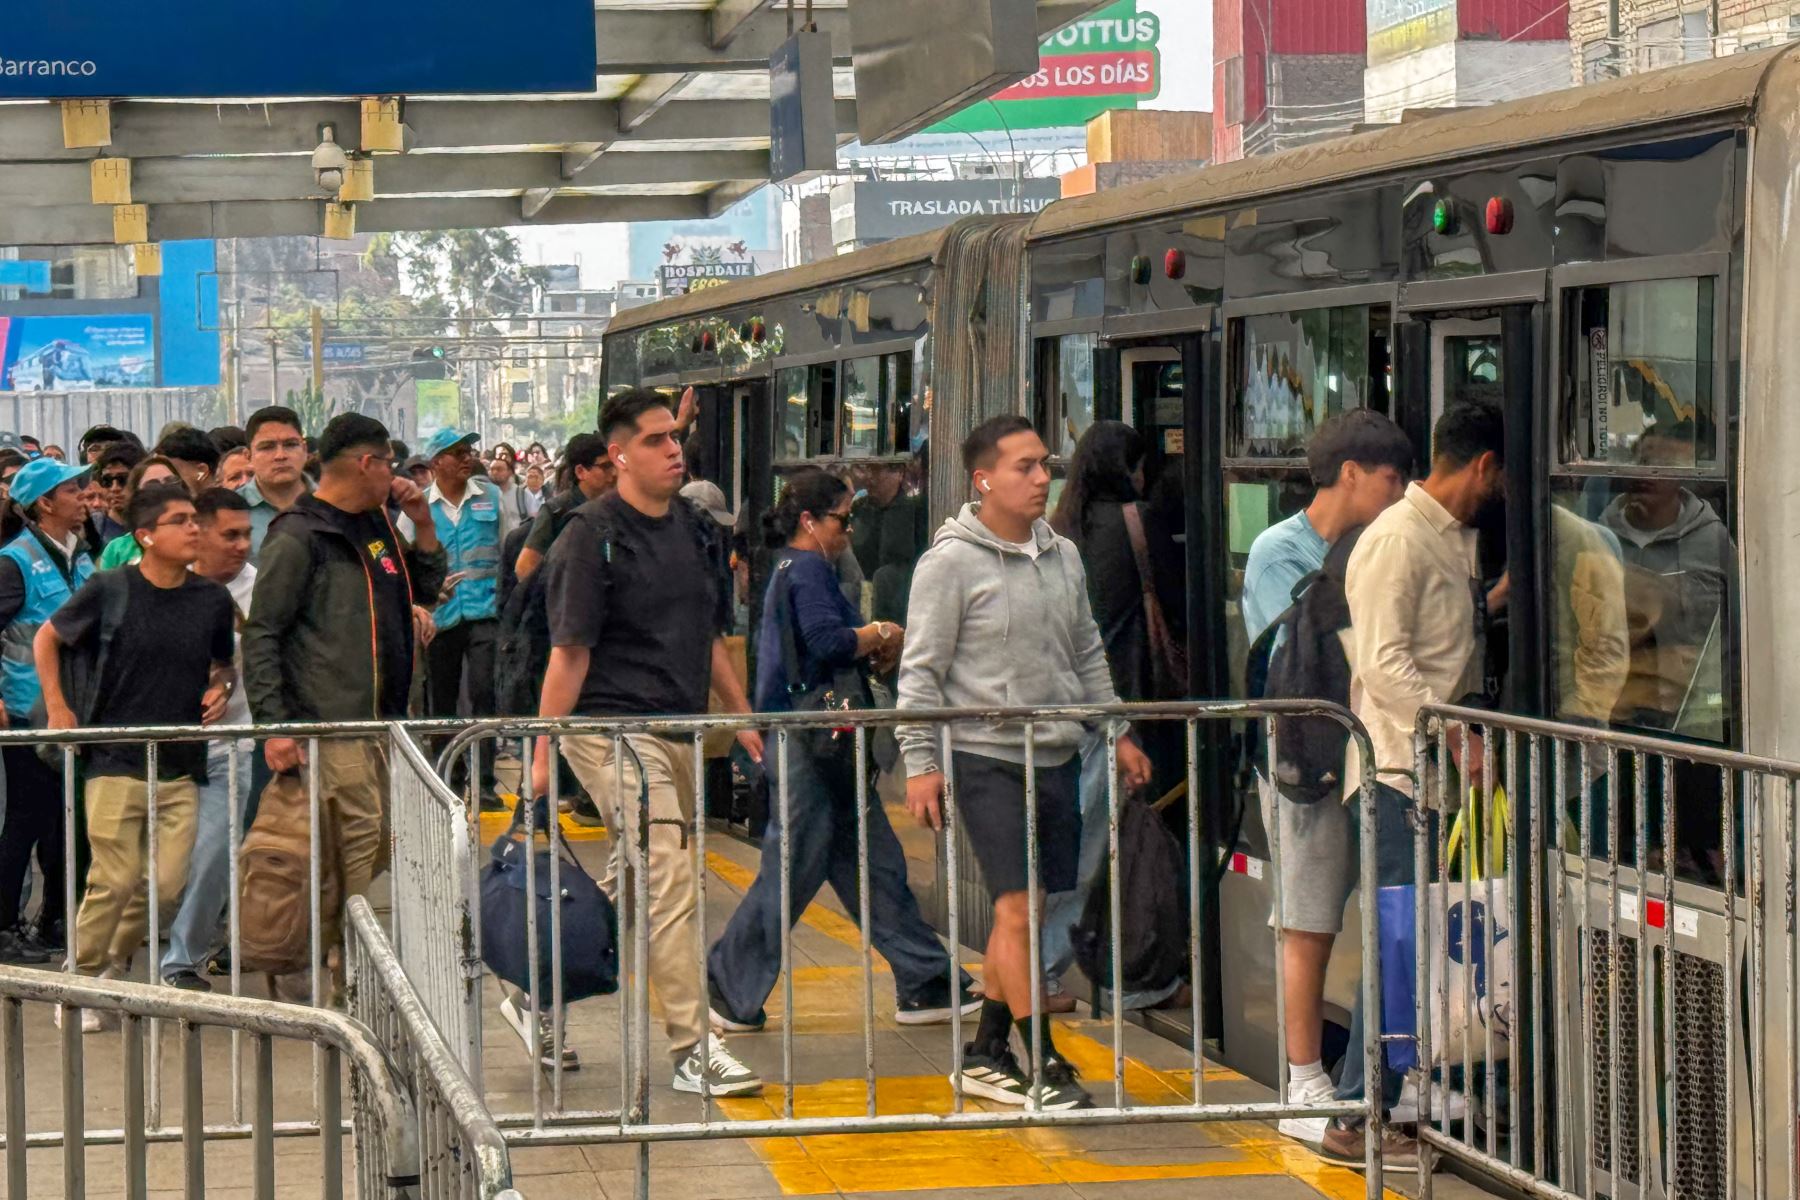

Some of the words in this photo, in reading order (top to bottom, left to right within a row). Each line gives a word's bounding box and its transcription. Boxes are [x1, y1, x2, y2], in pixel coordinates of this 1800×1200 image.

[1044, 18, 1154, 46] OTTUS
[1054, 66, 1095, 87] LOS
[1101, 58, 1149, 84] DÍAS
[888, 200, 984, 216] TRASLADA
[664, 265, 750, 278] HOSPEDAJE
[1598, 407, 1607, 423] NO
